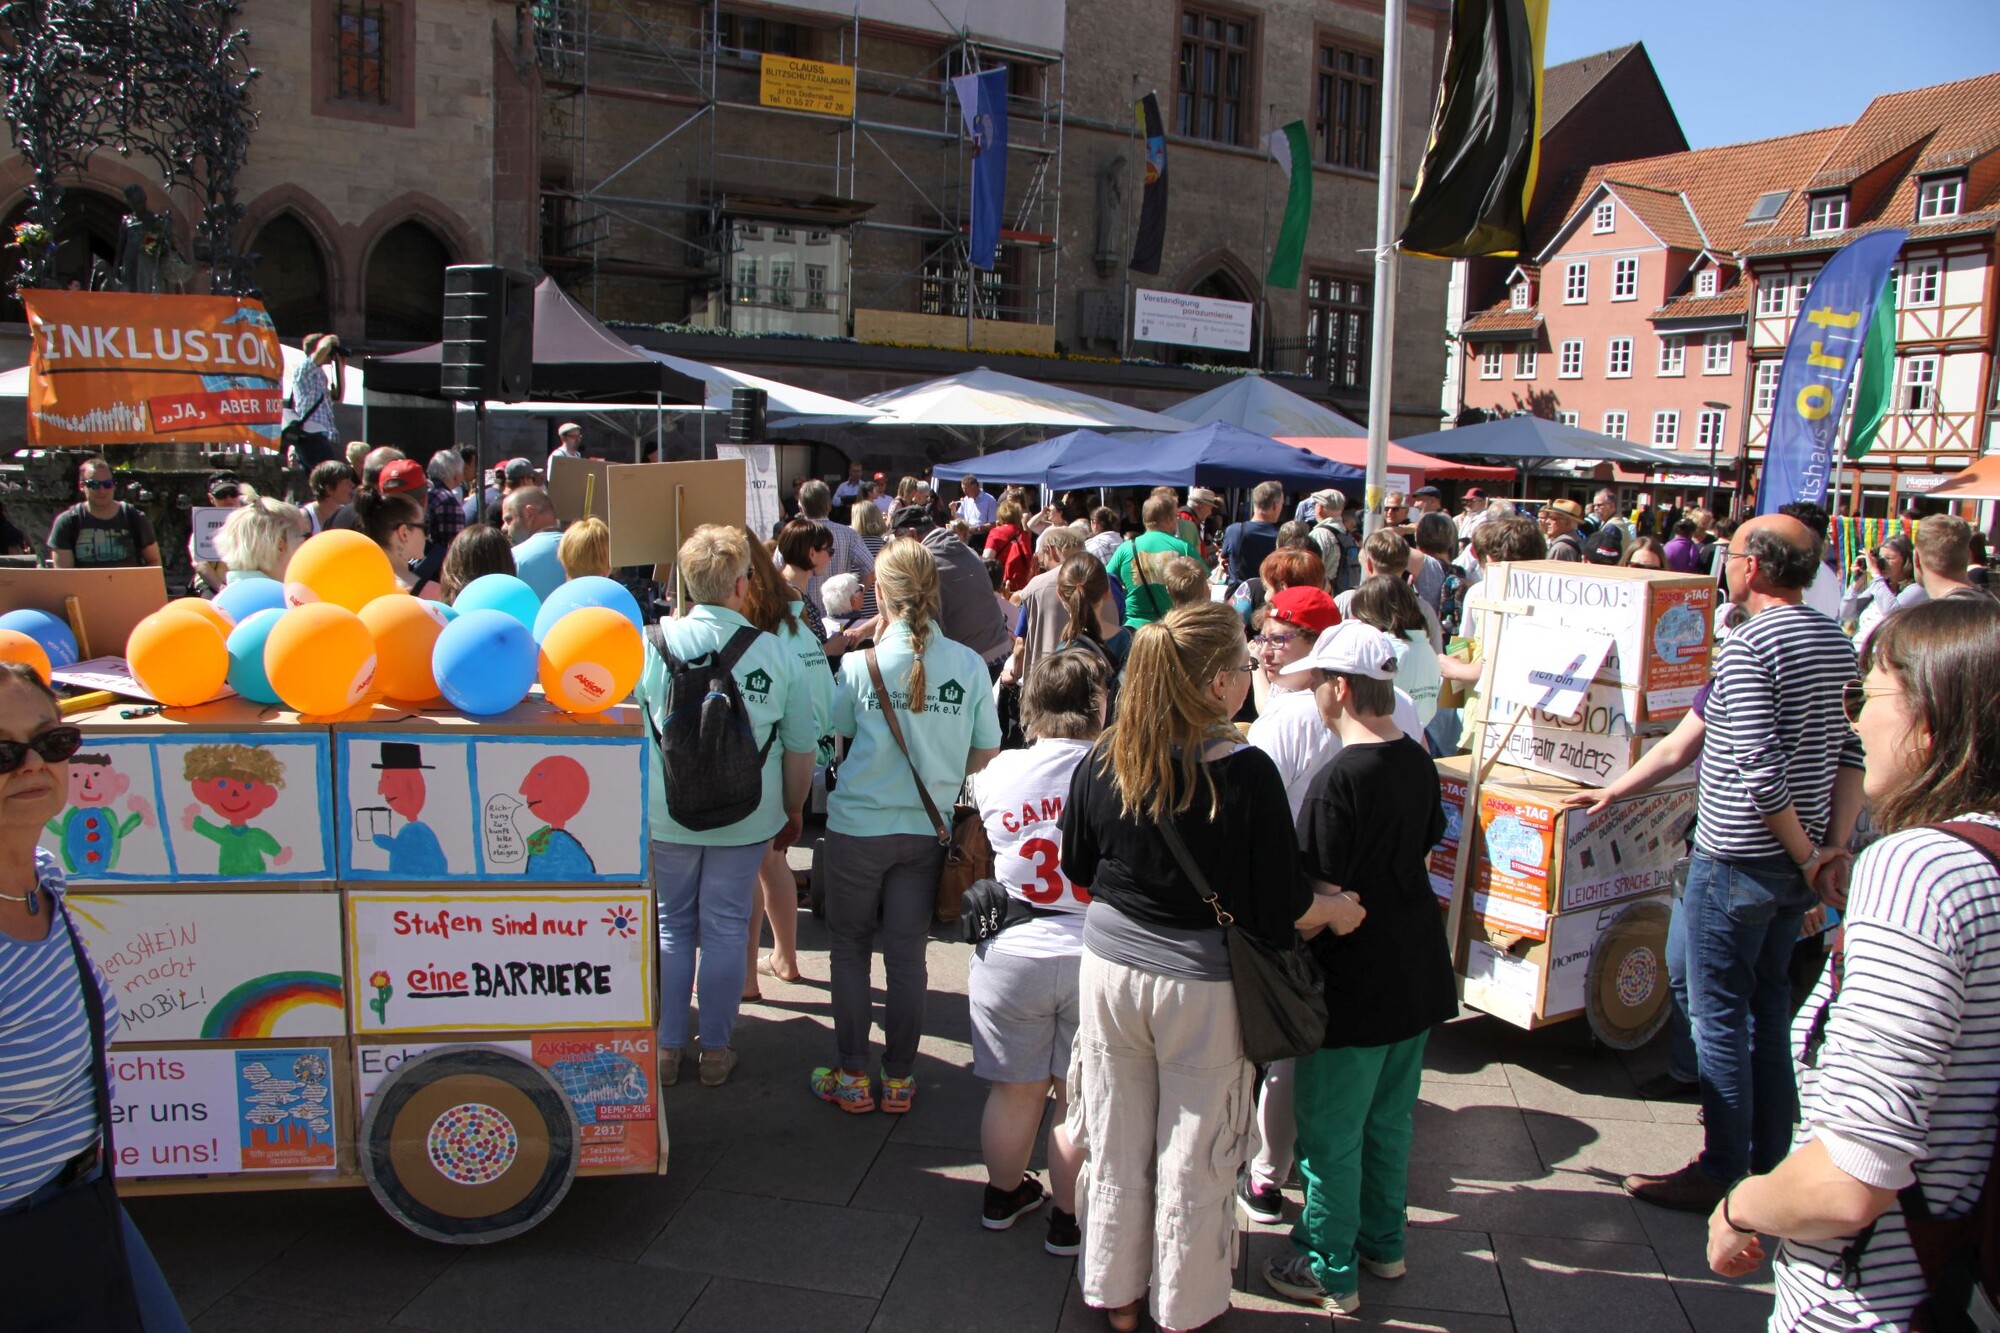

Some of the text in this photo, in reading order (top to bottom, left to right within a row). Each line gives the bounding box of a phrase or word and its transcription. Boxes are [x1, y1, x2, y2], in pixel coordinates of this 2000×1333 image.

[765, 67, 851, 86] BLITZSCHUTZANLAGEN
[788, 61, 825, 74] CLAUSS
[799, 90, 834, 101] Duderstadt
[1143, 293, 1200, 309] Verständigung
[1182, 307, 1233, 320] porozumienie
[39, 323, 276, 369] INKLUSION
[220, 398, 261, 415] ABER
[942, 705, 961, 715] e.V.
[1019, 837, 1093, 906] 3
[1567, 881, 1611, 906] LEICHTE
[393, 909, 588, 939] Stufen sind nur
[123, 956, 197, 993] macht
[407, 961, 612, 997] eine BARRIERE
[150, 1102, 208, 1122] uns
[600, 1104, 651, 1115] DEMO-ZUG
[594, 1125, 624, 1136] 2017
[152, 1138, 218, 1165] uns!
